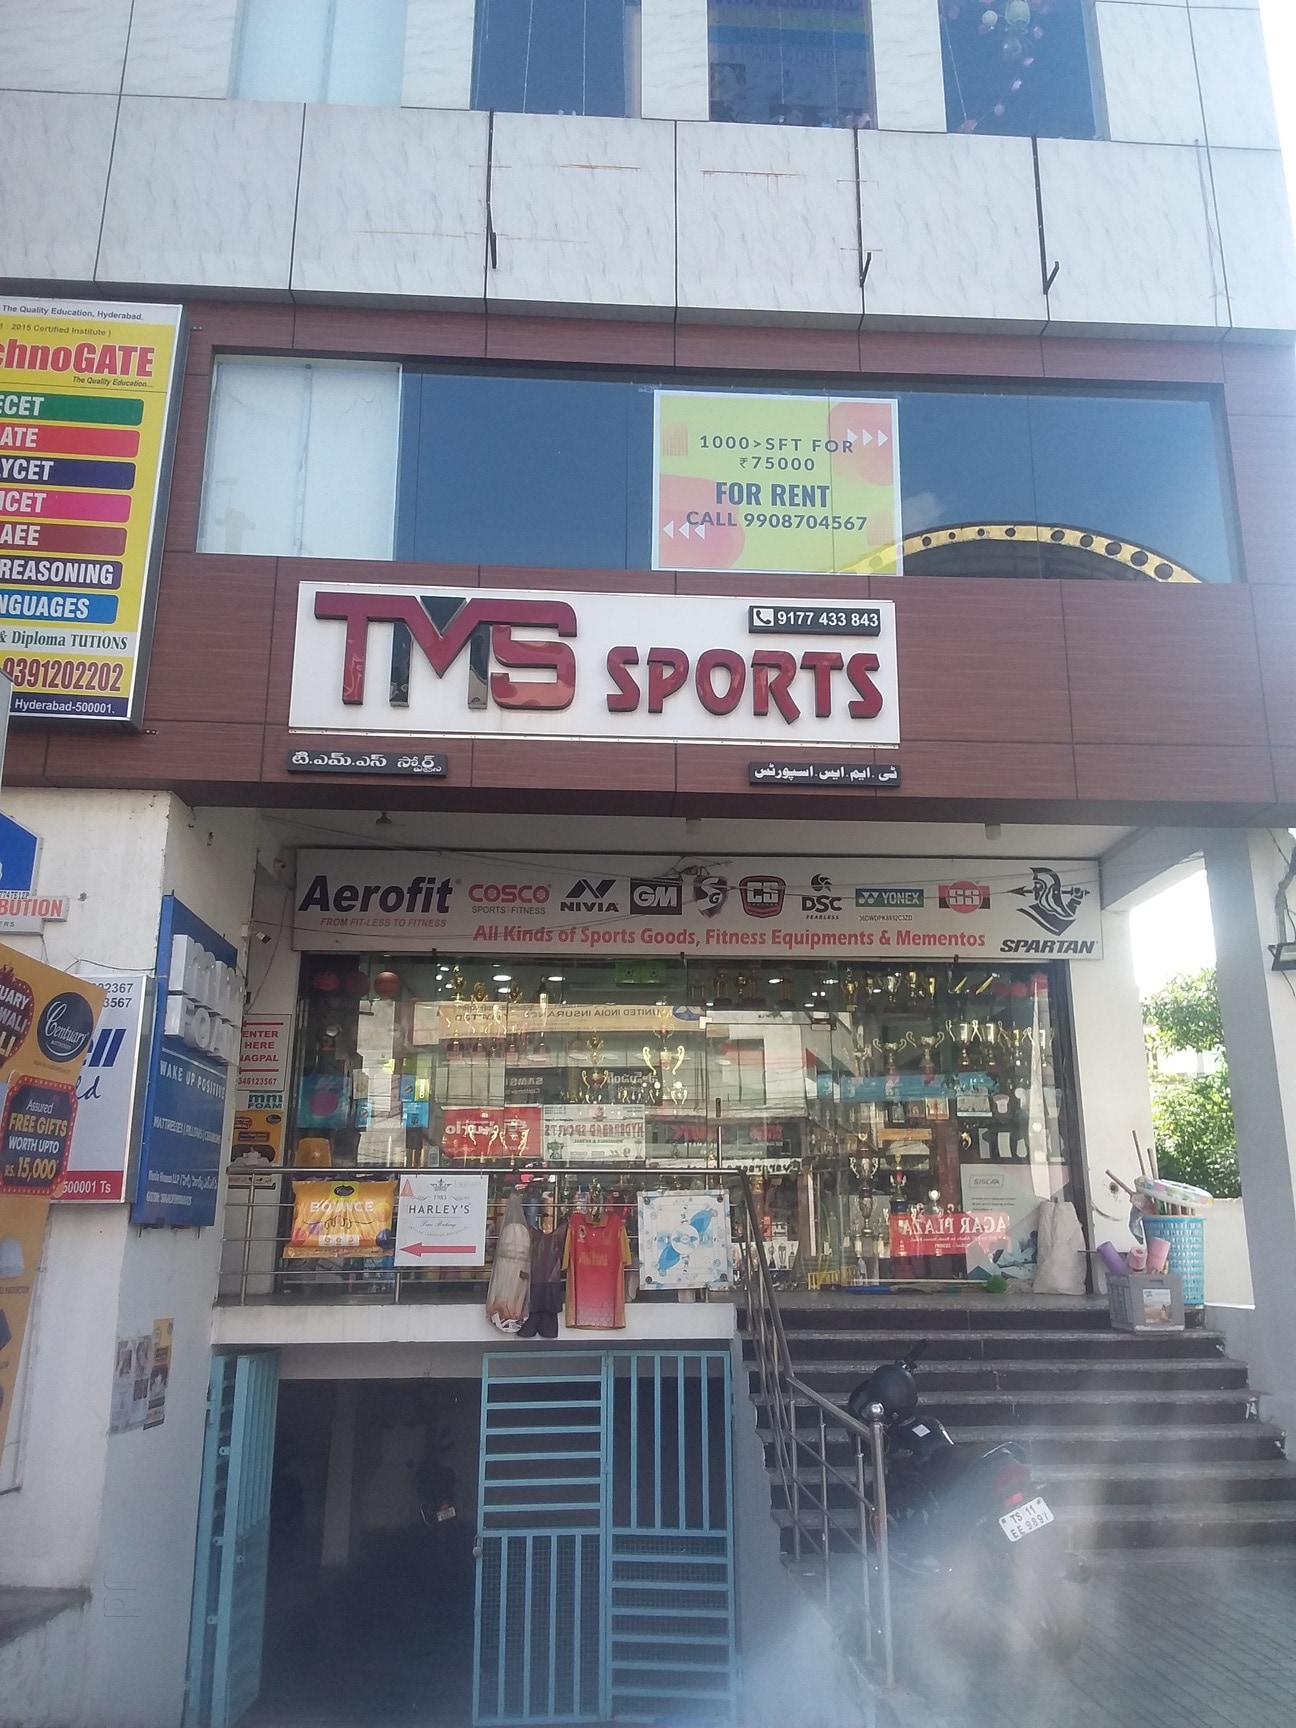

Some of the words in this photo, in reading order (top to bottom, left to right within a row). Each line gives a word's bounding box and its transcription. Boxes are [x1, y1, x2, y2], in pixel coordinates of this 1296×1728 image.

[2, 304, 17, 313] The
[20, 305, 49, 316] Quality
[52, 308, 95, 318] Education,
[97, 310, 144, 320] Hyderabad.
[12, 323, 31, 331] 2015
[34, 325, 69, 334] Certified
[72, 327, 106, 336] Institute
[72, 376, 85, 384] The
[87, 377, 112, 386] Quality
[812, 439, 854, 453] FOR
[0, 458, 54, 481] YCET
[739, 456, 815, 471] ₹75000
[716, 482, 762, 506] FOR
[771, 484, 830, 508] RENT
[686, 511, 737, 527] CALL
[744, 514, 868, 530] 9908704567
[0, 558, 114, 584] REASONING
[777, 610, 815, 626] 9177
[818, 611, 846, 626] 433
[851, 612, 878, 628] 843
[12, 630, 66, 648] Diploma
[70, 634, 128, 650] TUTIONS
[313, 590, 578, 711] TMS
[606, 645, 884, 726] SPORTS
[298, 875, 453, 914] Aerofit
[468, 884, 550, 904] COSCO
[633, 885, 678, 908] GM
[882, 892, 920, 904] YONEX
[472, 906, 506, 914] SPORTS
[511, 906, 546, 916] FITNESS
[560, 902, 617, 912] NIVIA
[802, 895, 842, 913] DSC
[320, 917, 348, 926] FROM
[350, 918, 390, 927] FIT-LESS
[394, 918, 406, 927] TO
[408, 918, 447, 928] FITNESS
[473, 925, 498, 942] All
[504, 926, 553, 943] Kinds
[558, 927, 576, 943] of
[581, 928, 636, 948] Sports
[640, 928, 700, 947] Goods,
[706, 930, 766, 945] Fitness
[772, 929, 874, 950] Equipments
[880, 931, 894, 946] &
[896, 930, 986, 947] Mementos
[1000, 940, 1097, 954] SPARTAN
[242, 1030, 279, 1038] ENTER
[244, 1042, 275, 1050] HERE
[160, 1060, 183, 1082] WAKE
[186, 1070, 195, 1086] UP
[198, 1076, 226, 1100] POSITIVE
[26, 1099, 54, 1114] Assured
[9, 1112, 36, 1134] FREE
[36, 1117, 68, 1136] GIFTS
[8, 1136, 37, 1152] WORTH
[38, 1140, 60, 1154] UPTO
[100, 1180, 112, 1194] Ts
[310, 1200, 375, 1213] BOUNCE
[408, 1204, 470, 1214] HARLEY'S
[1010, 1512, 1023, 1524] TS
[1025, 1504, 1036, 1516] 11
[1010, 1525, 1026, 1538] EE
